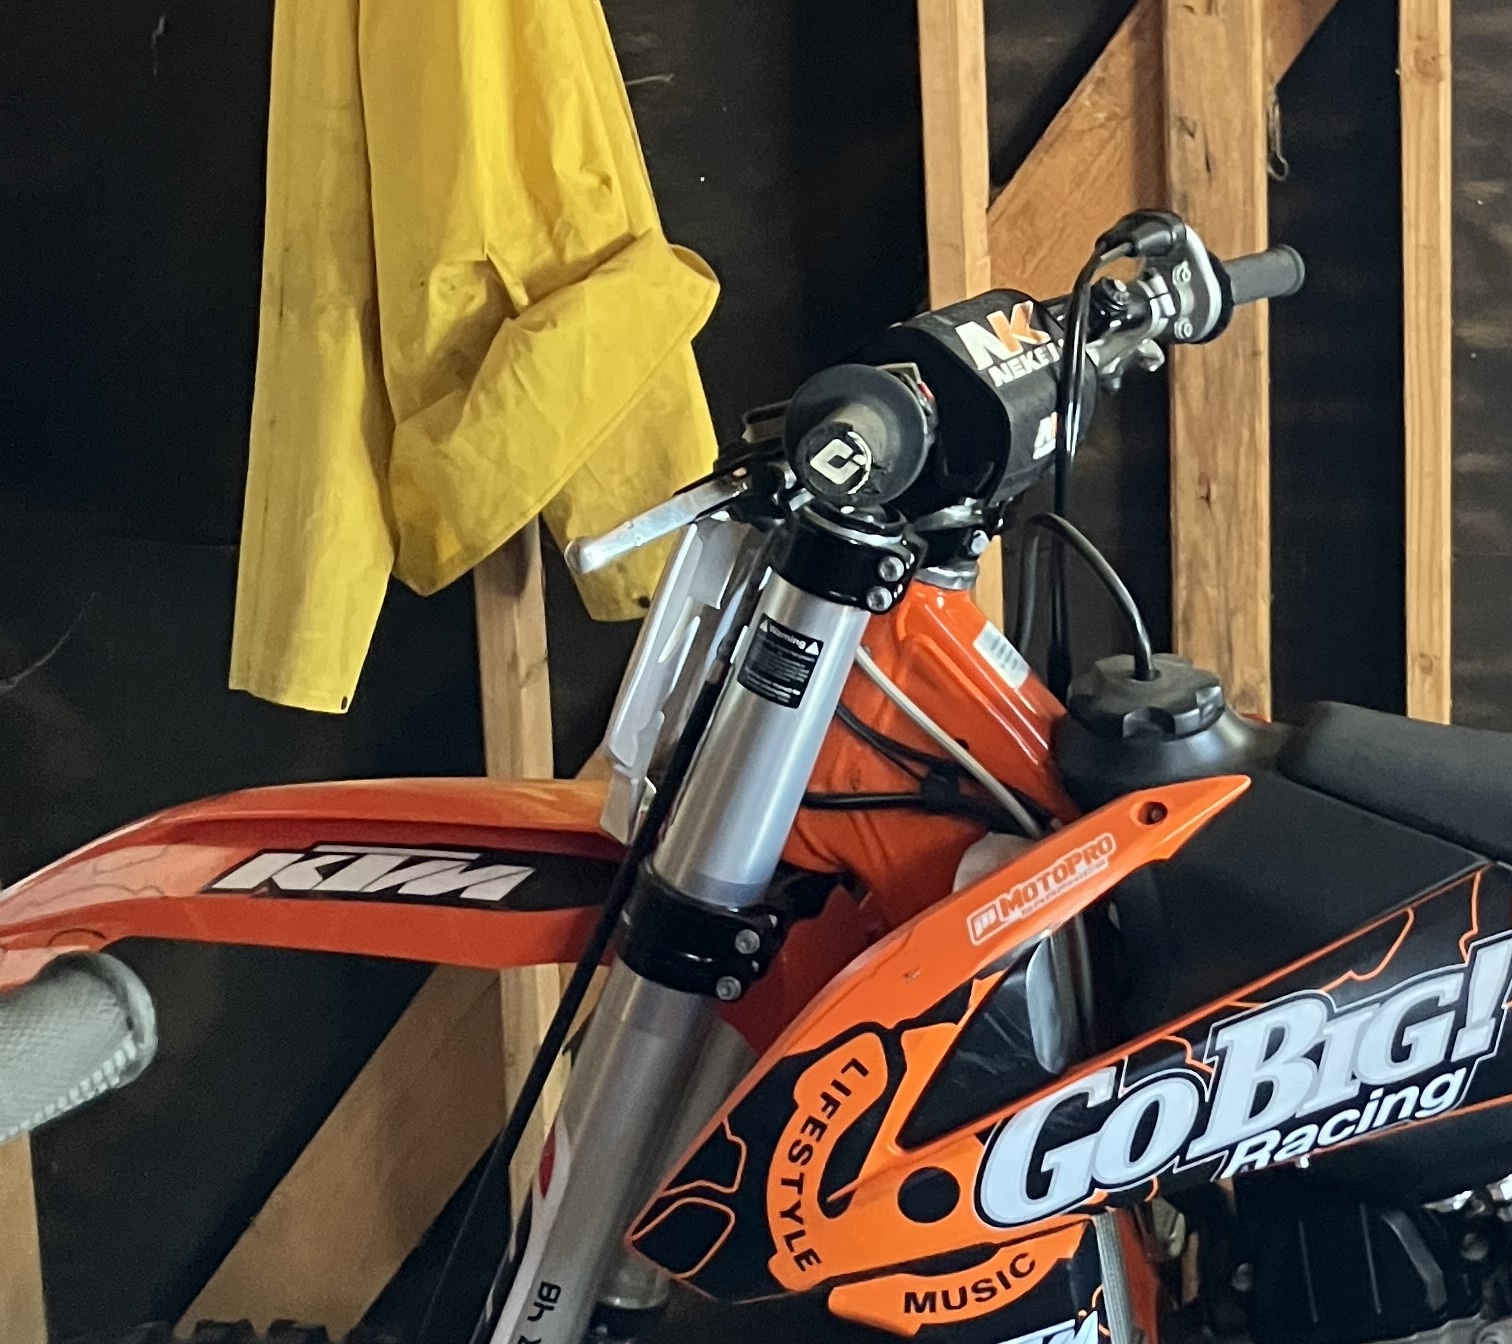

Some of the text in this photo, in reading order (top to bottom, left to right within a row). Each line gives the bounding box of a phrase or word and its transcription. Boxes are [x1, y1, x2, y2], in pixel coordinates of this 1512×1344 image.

[212, 844, 536, 902] KTM
[999, 834, 1114, 918] MOTOPRO
[1221, 1068, 1466, 1178] Racing
[779, 1058, 869, 1273] LIFESTYLE
[526, 1280, 562, 1323] 48
[903, 1253, 1037, 1316] MUSIC
